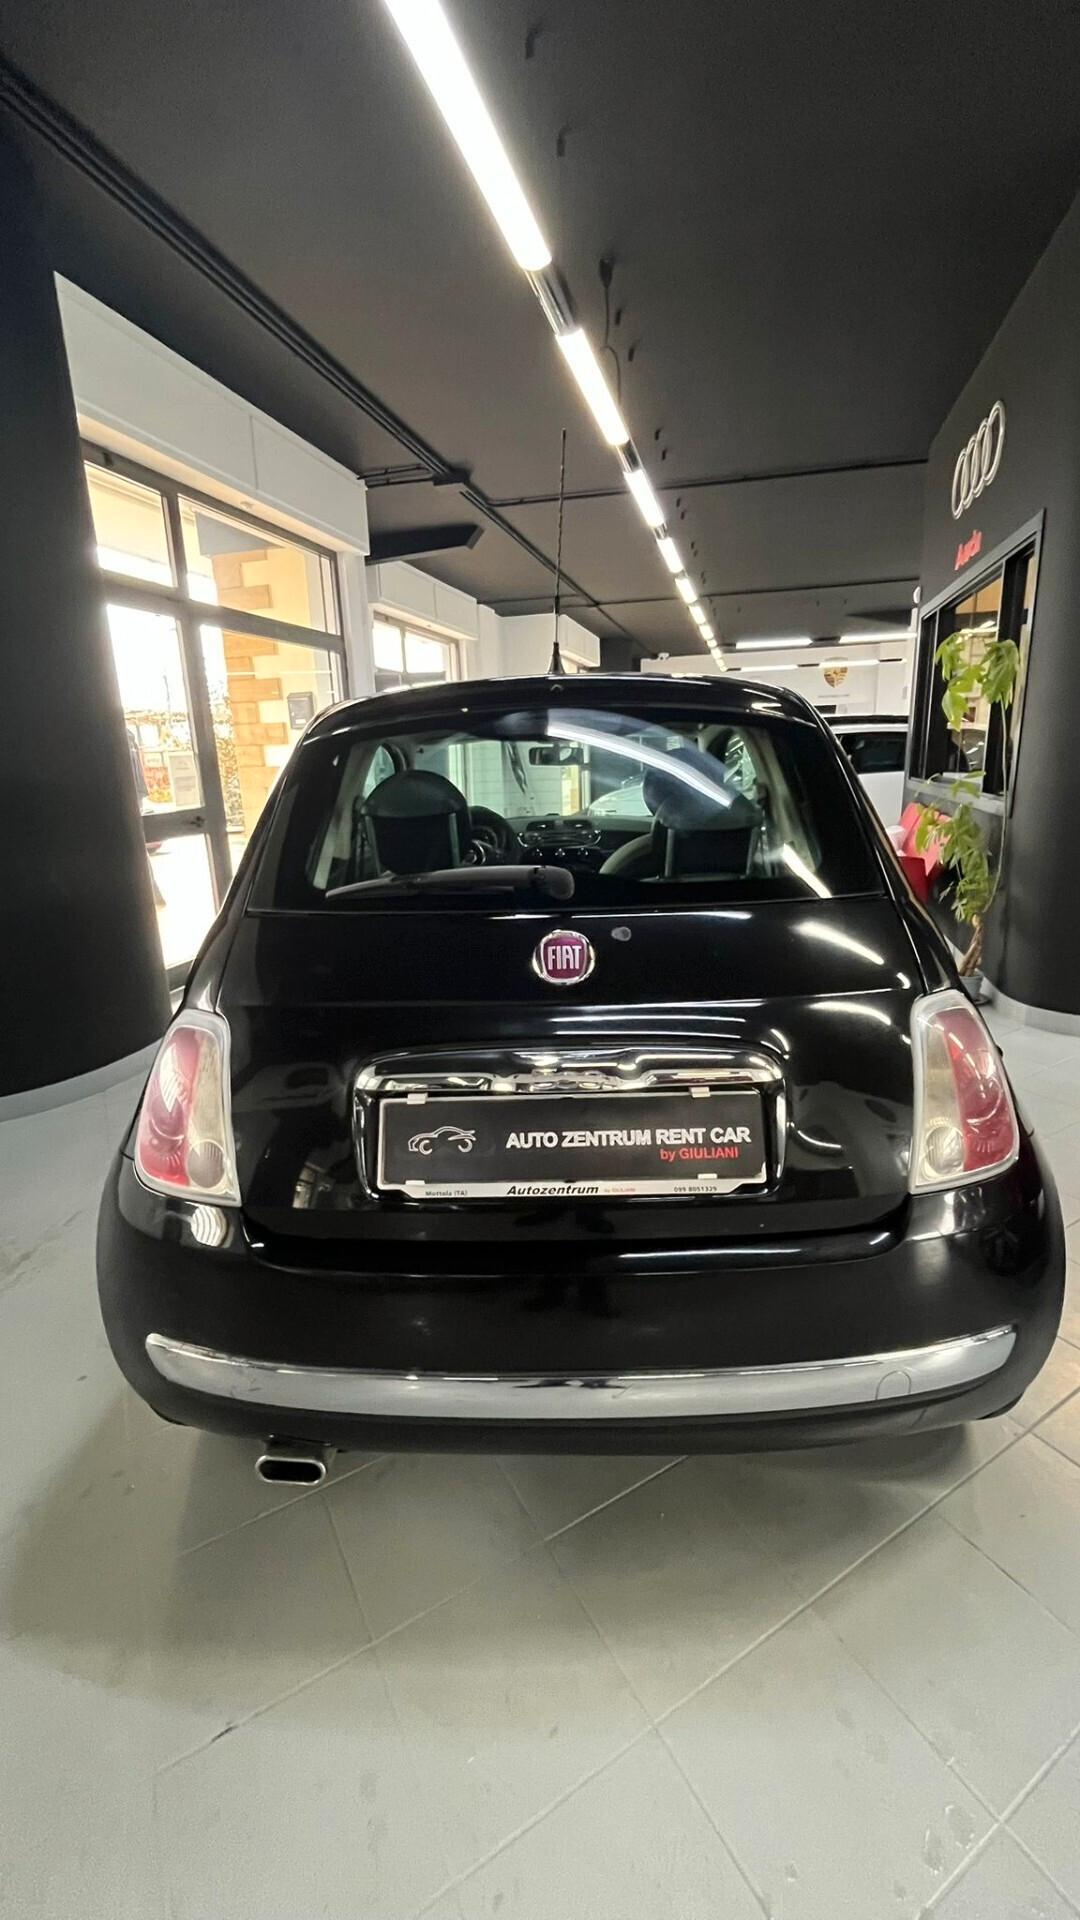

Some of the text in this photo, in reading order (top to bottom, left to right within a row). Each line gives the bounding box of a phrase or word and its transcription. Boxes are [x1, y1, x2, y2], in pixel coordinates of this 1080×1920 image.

[547, 945, 583, 970] FIAT
[505, 1126, 752, 1149] AUTO ZENTRUM RENT CAR
[660, 1146, 739, 1163] by GIULIANI
[507, 1185, 599, 1196] Autozentrum
